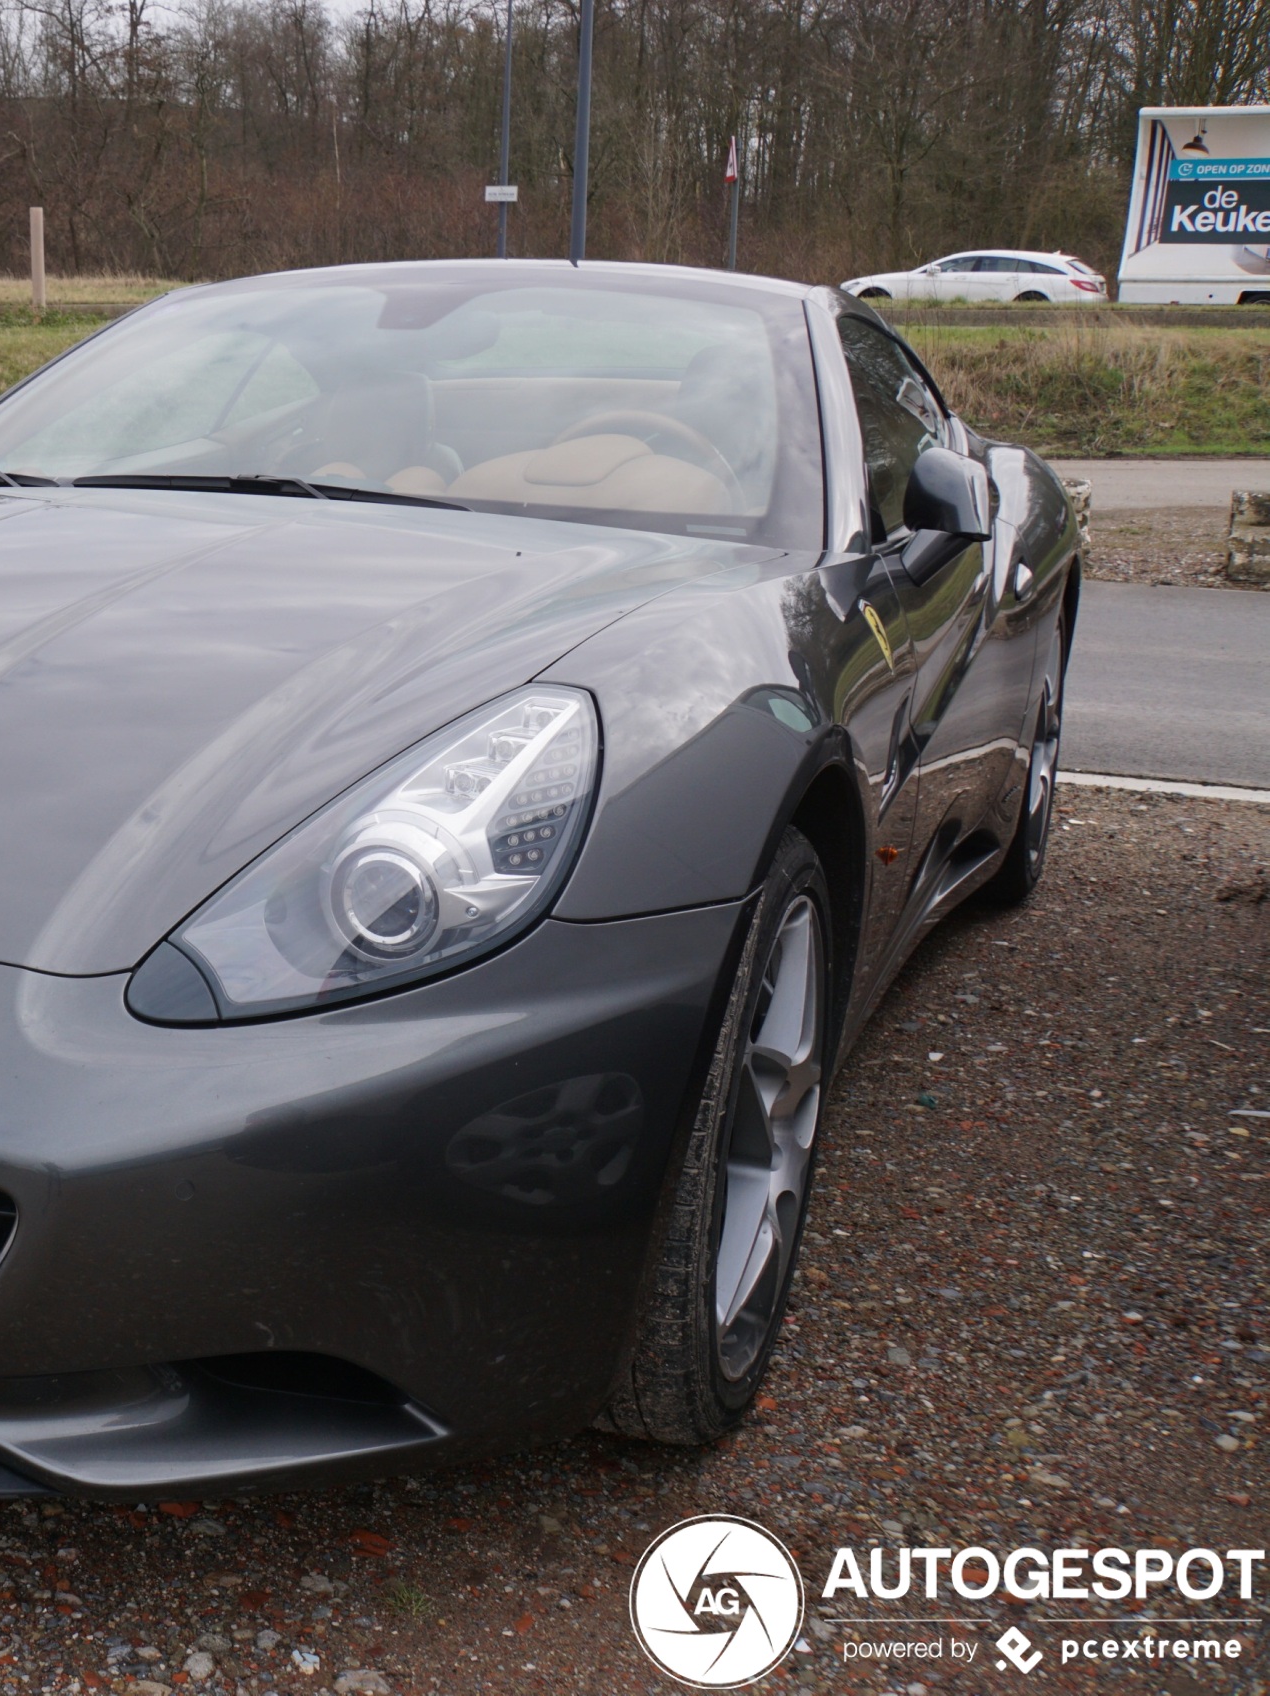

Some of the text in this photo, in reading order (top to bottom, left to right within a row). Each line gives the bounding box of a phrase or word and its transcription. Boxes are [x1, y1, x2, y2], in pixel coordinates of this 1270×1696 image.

[1197, 164, 1228, 175] OPEN
[1229, 164, 1246, 174] OP
[1203, 185, 1239, 209] de
[1170, 204, 1270, 232] Keuke
